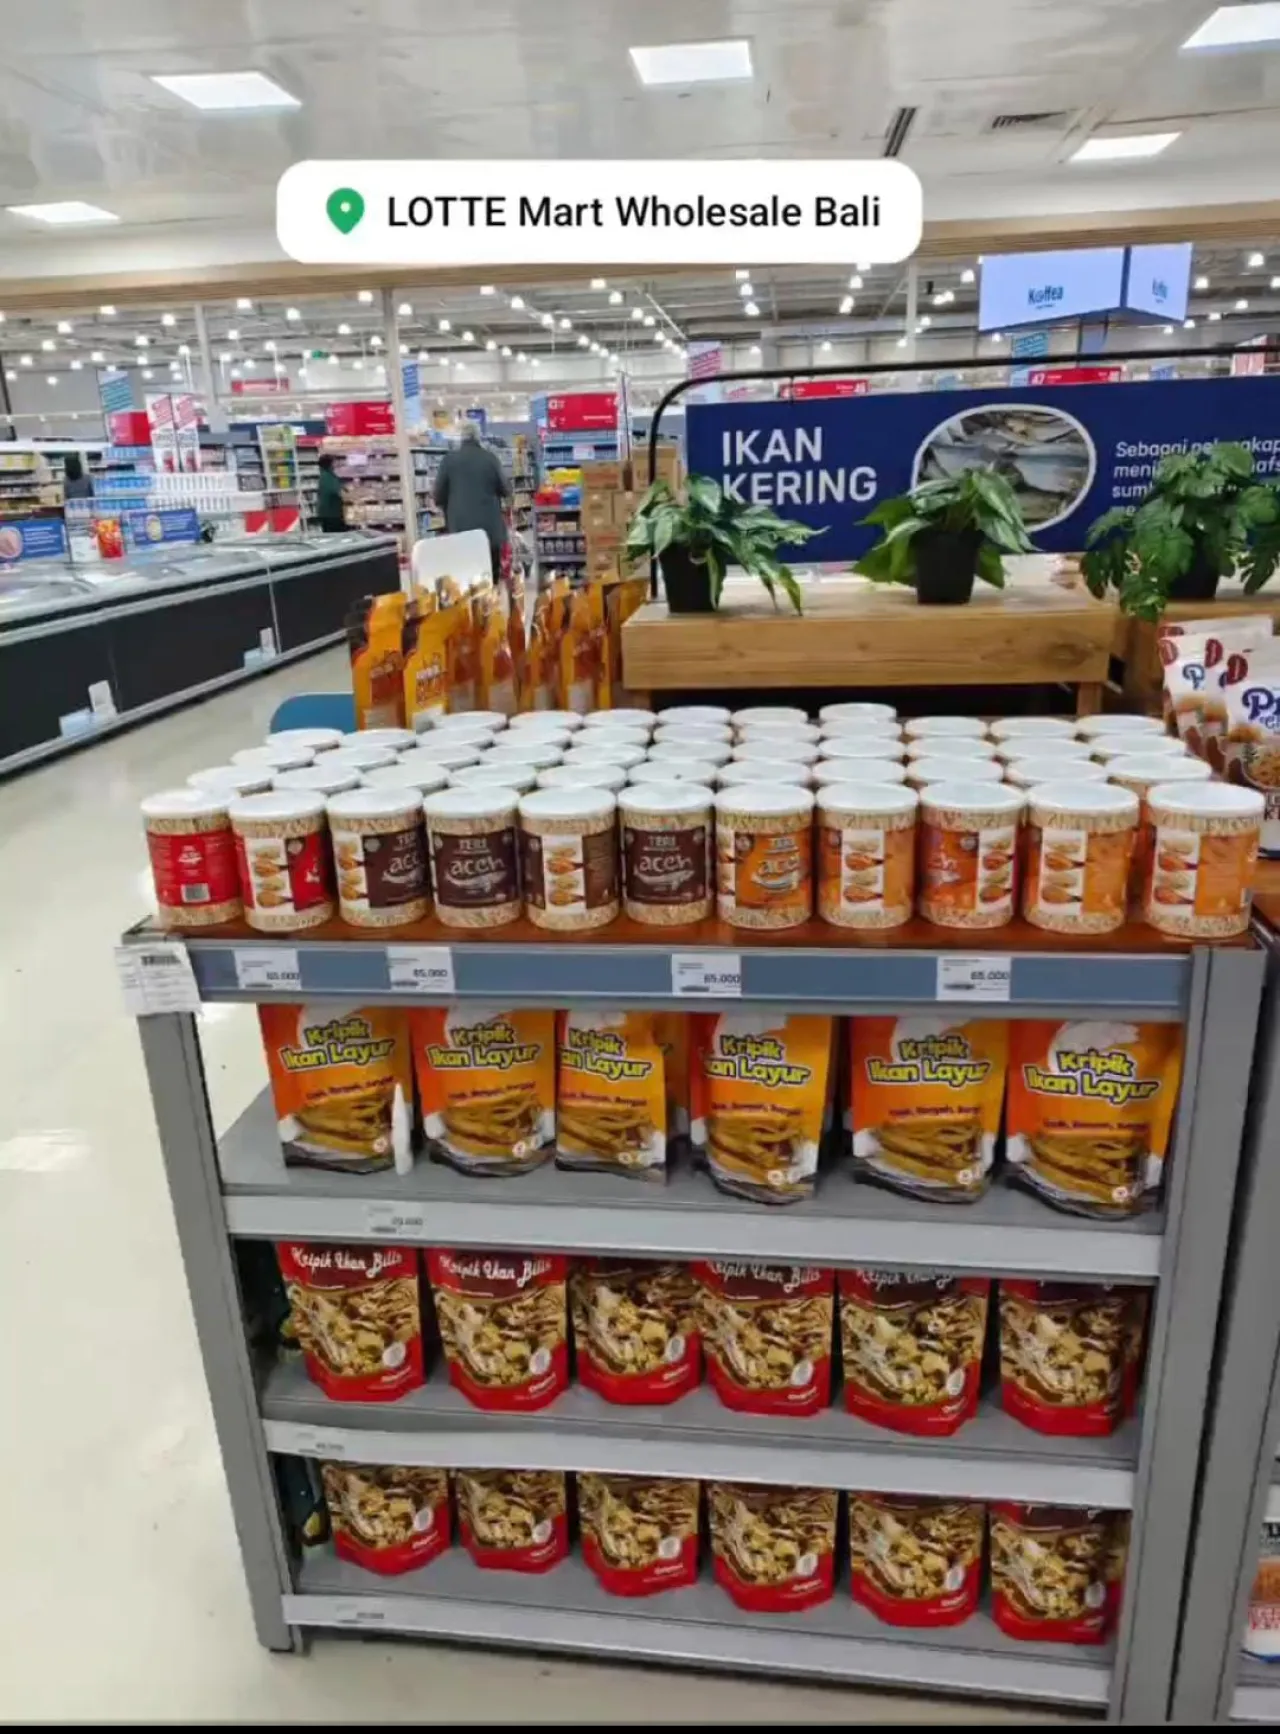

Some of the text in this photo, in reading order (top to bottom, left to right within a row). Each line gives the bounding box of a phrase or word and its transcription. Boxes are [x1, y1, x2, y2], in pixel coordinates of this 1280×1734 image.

[722, 426, 823, 467] IKAN
[722, 466, 878, 506] KERING
[703, 973, 741, 984] 65.000
[305, 1020, 367, 1045] Kripik
[452, 1024, 513, 1046] Kripik
[569, 1028, 622, 1055] Kripik
[281, 1040, 393, 1069] Ikan Layur
[429, 1045, 539, 1069] Ikan Layur
[721, 1035, 782, 1060] Kripik
[899, 1036, 966, 1061] Kripik
[586, 1051, 651, 1080] Layur
[739, 1056, 810, 1086] Layur
[869, 1058, 988, 1087] Ikan Layur
[1057, 1049, 1133, 1076] Kripik
[1024, 1066, 1158, 1104] Ikan Layur
